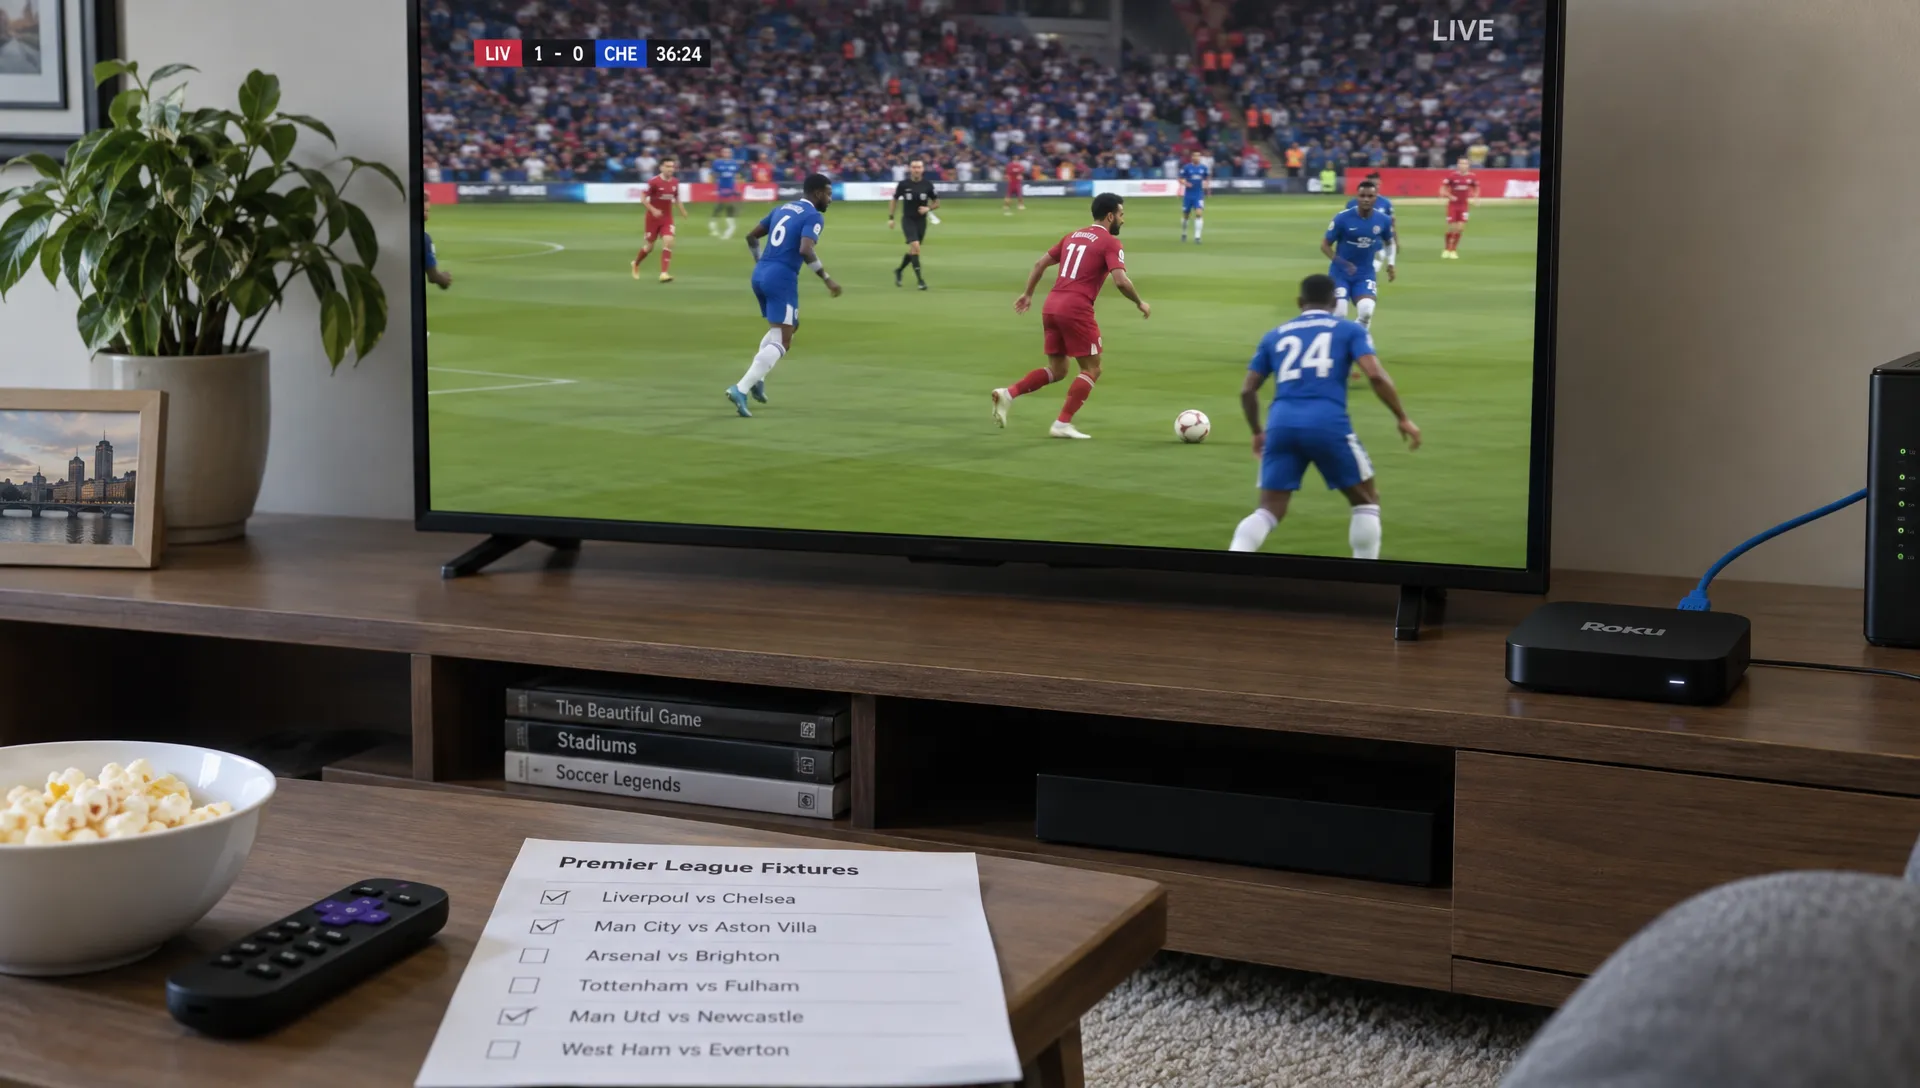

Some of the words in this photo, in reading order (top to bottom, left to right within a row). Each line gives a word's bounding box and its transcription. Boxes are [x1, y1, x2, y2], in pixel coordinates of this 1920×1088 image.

[1433, 19, 1494, 41] LIVE
[485, 46, 511, 61] LIV
[534, 46, 542, 61] 1
[573, 46, 584, 61] 0
[604, 46, 638, 61] CHE
[656, 46, 702, 61] 36:24
[770, 215, 791, 247] 6
[1060, 243, 1087, 280] 11
[1275, 332, 1334, 383] 24
[1580, 621, 1666, 636] Roku
[556, 700, 583, 716] The
[588, 702, 654, 723] Beautiful
[658, 708, 702, 727] Game
[558, 731, 637, 755] Stadiums
[556, 764, 609, 784] Soccer
[614, 770, 681, 792] Legends
[559, 856, 658, 871] Premier
[665, 860, 754, 876] League
[761, 862, 859, 876] Fixtures
[602, 891, 689, 905] Liverpoul
[696, 894, 716, 904] vs
[722, 893, 796, 904] Chelsea
[594, 921, 636, 932] Man
[643, 921, 681, 934] City
[688, 924, 708, 932] vs
[715, 921, 770, 933] Aston
[777, 921, 817, 933] Villa
[585, 949, 661, 962] Arsenal
[668, 952, 688, 961] vs
[696, 950, 780, 965] Brighton
[579, 979, 688, 992] Tottenham
[696, 982, 718, 992] vs
[725, 979, 800, 992] Fulham
[569, 1009, 615, 1023] Man
[623, 1009, 660, 1023] Utd
[668, 1012, 690, 1023] vs
[698, 1010, 804, 1023] Newcastle
[562, 1042, 614, 1057] West
[621, 1042, 671, 1057] Ham
[678, 1045, 701, 1057] vs
[709, 1042, 790, 1057] Everton
